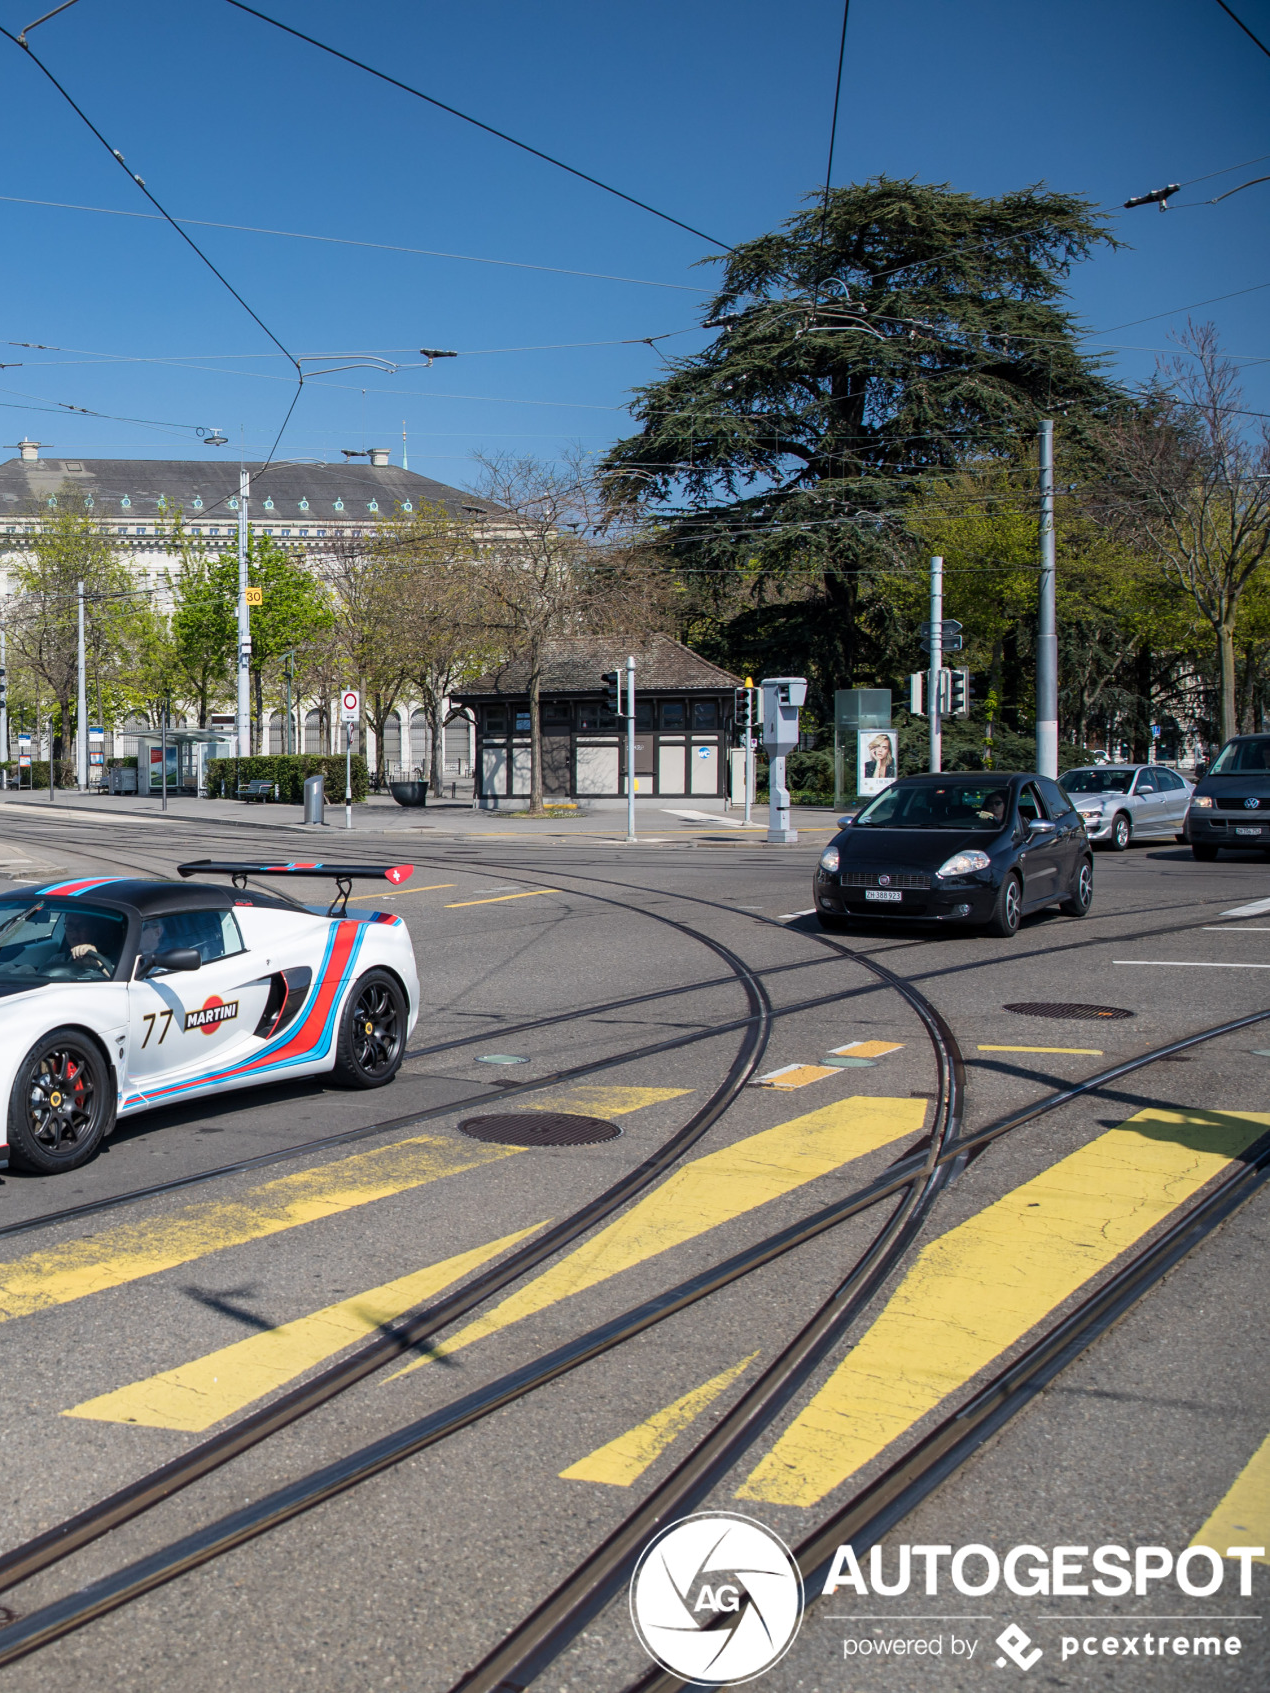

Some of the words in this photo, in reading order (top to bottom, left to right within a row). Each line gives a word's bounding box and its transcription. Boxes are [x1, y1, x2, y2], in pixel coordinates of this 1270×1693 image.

[246, 592, 261, 602] 30
[697, 750, 711, 758] WC
[186, 1003, 237, 1028] MARTINI
[140, 1008, 174, 1049] 77
